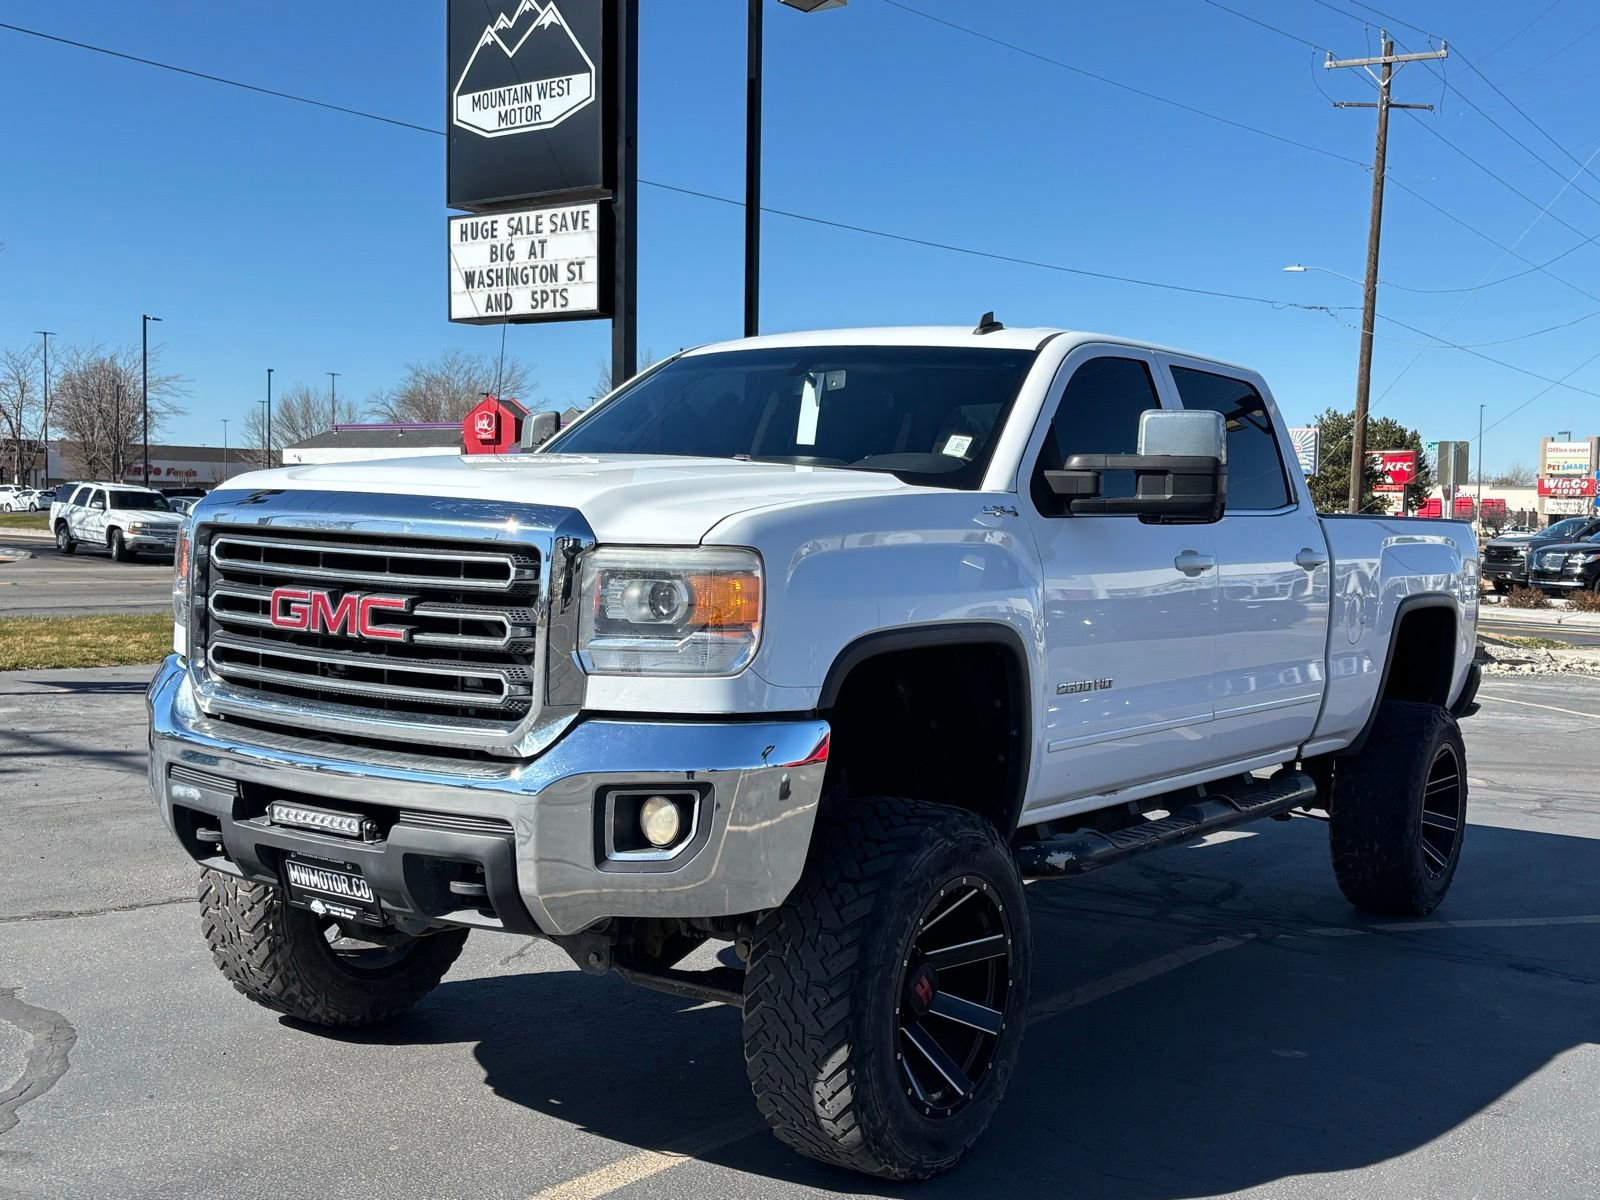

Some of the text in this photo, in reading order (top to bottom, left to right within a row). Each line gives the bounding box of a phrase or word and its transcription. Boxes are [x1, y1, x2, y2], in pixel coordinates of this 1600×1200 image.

[472, 78, 573, 112] MOUNTAIN WEST
[498, 104, 542, 127] MOTOR
[460, 210, 590, 242] HUGE SALE SAVE
[489, 239, 547, 263] BIG AT
[464, 260, 585, 290] WASHINGTON ST
[485, 288, 569, 313] AND 5PTS
[1384, 461, 1413, 472] KFC
[271, 588, 407, 643] GMC
[1056, 681, 1093, 695] 2500
[288, 863, 370, 899] MWMOTOR.CO
